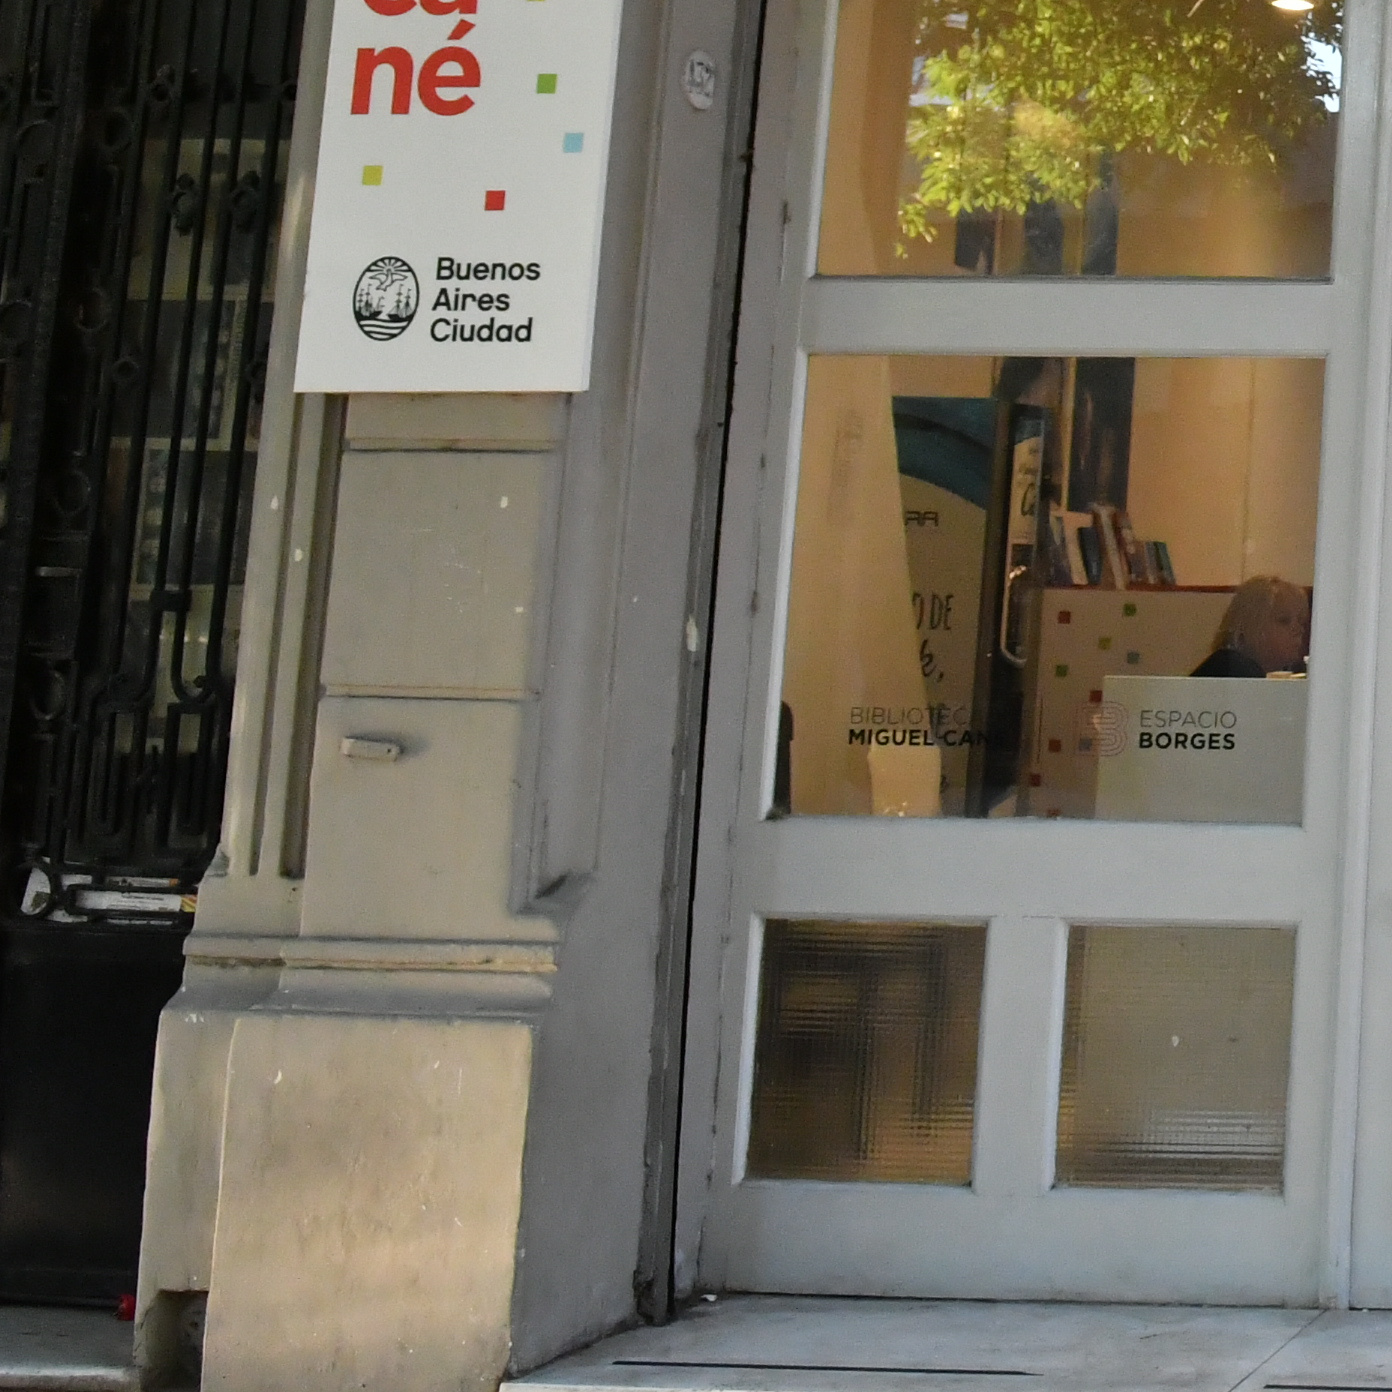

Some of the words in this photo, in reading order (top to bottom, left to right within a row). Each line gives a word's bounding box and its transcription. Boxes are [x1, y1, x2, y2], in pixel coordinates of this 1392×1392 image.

[350, 18, 482, 117] né
[435, 256, 541, 281] Buenos
[431, 287, 511, 312] Aires
[429, 316, 534, 343] Ciudad
[1139, 709, 1238, 729] ESPACIO
[848, 729, 935, 747] MIGUEL
[1138, 732, 1236, 751] BORGES
